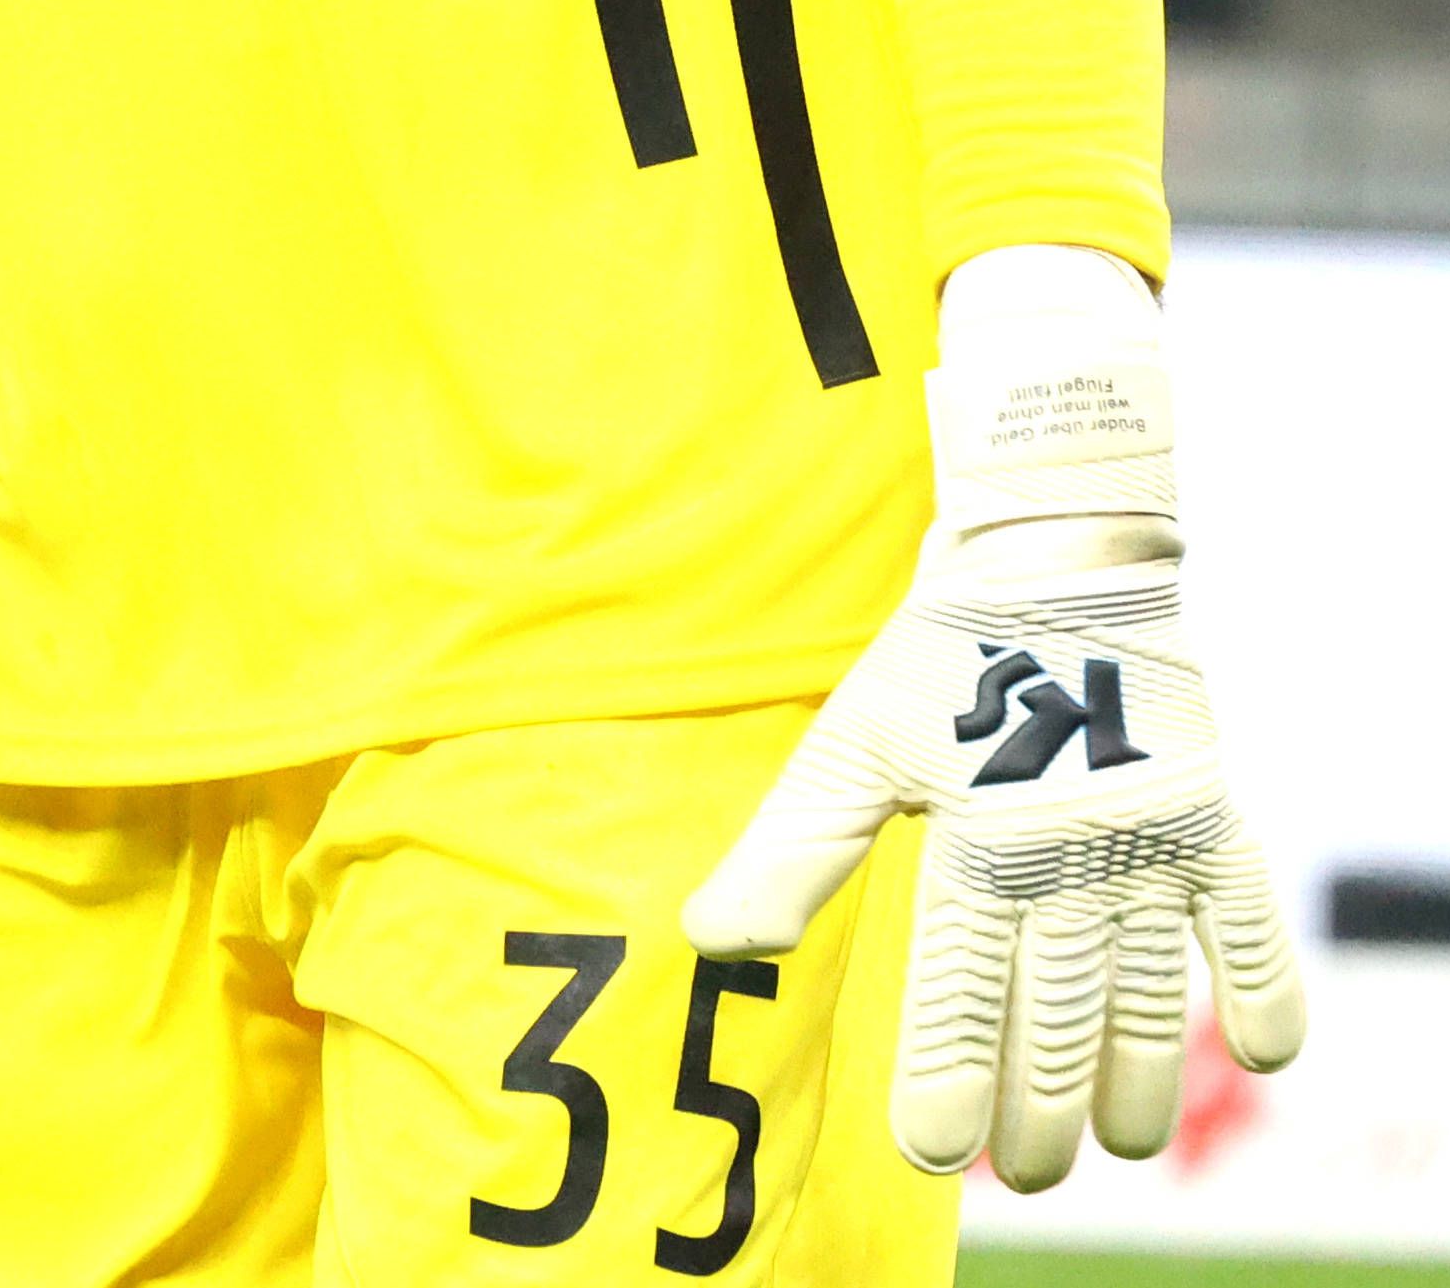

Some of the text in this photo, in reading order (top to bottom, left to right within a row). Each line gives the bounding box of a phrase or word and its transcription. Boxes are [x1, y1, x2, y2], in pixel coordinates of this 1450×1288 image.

[996, 404, 1044, 423] ohne
[1051, 399, 1092, 415] man
[468, 930, 780, 1277] 35
